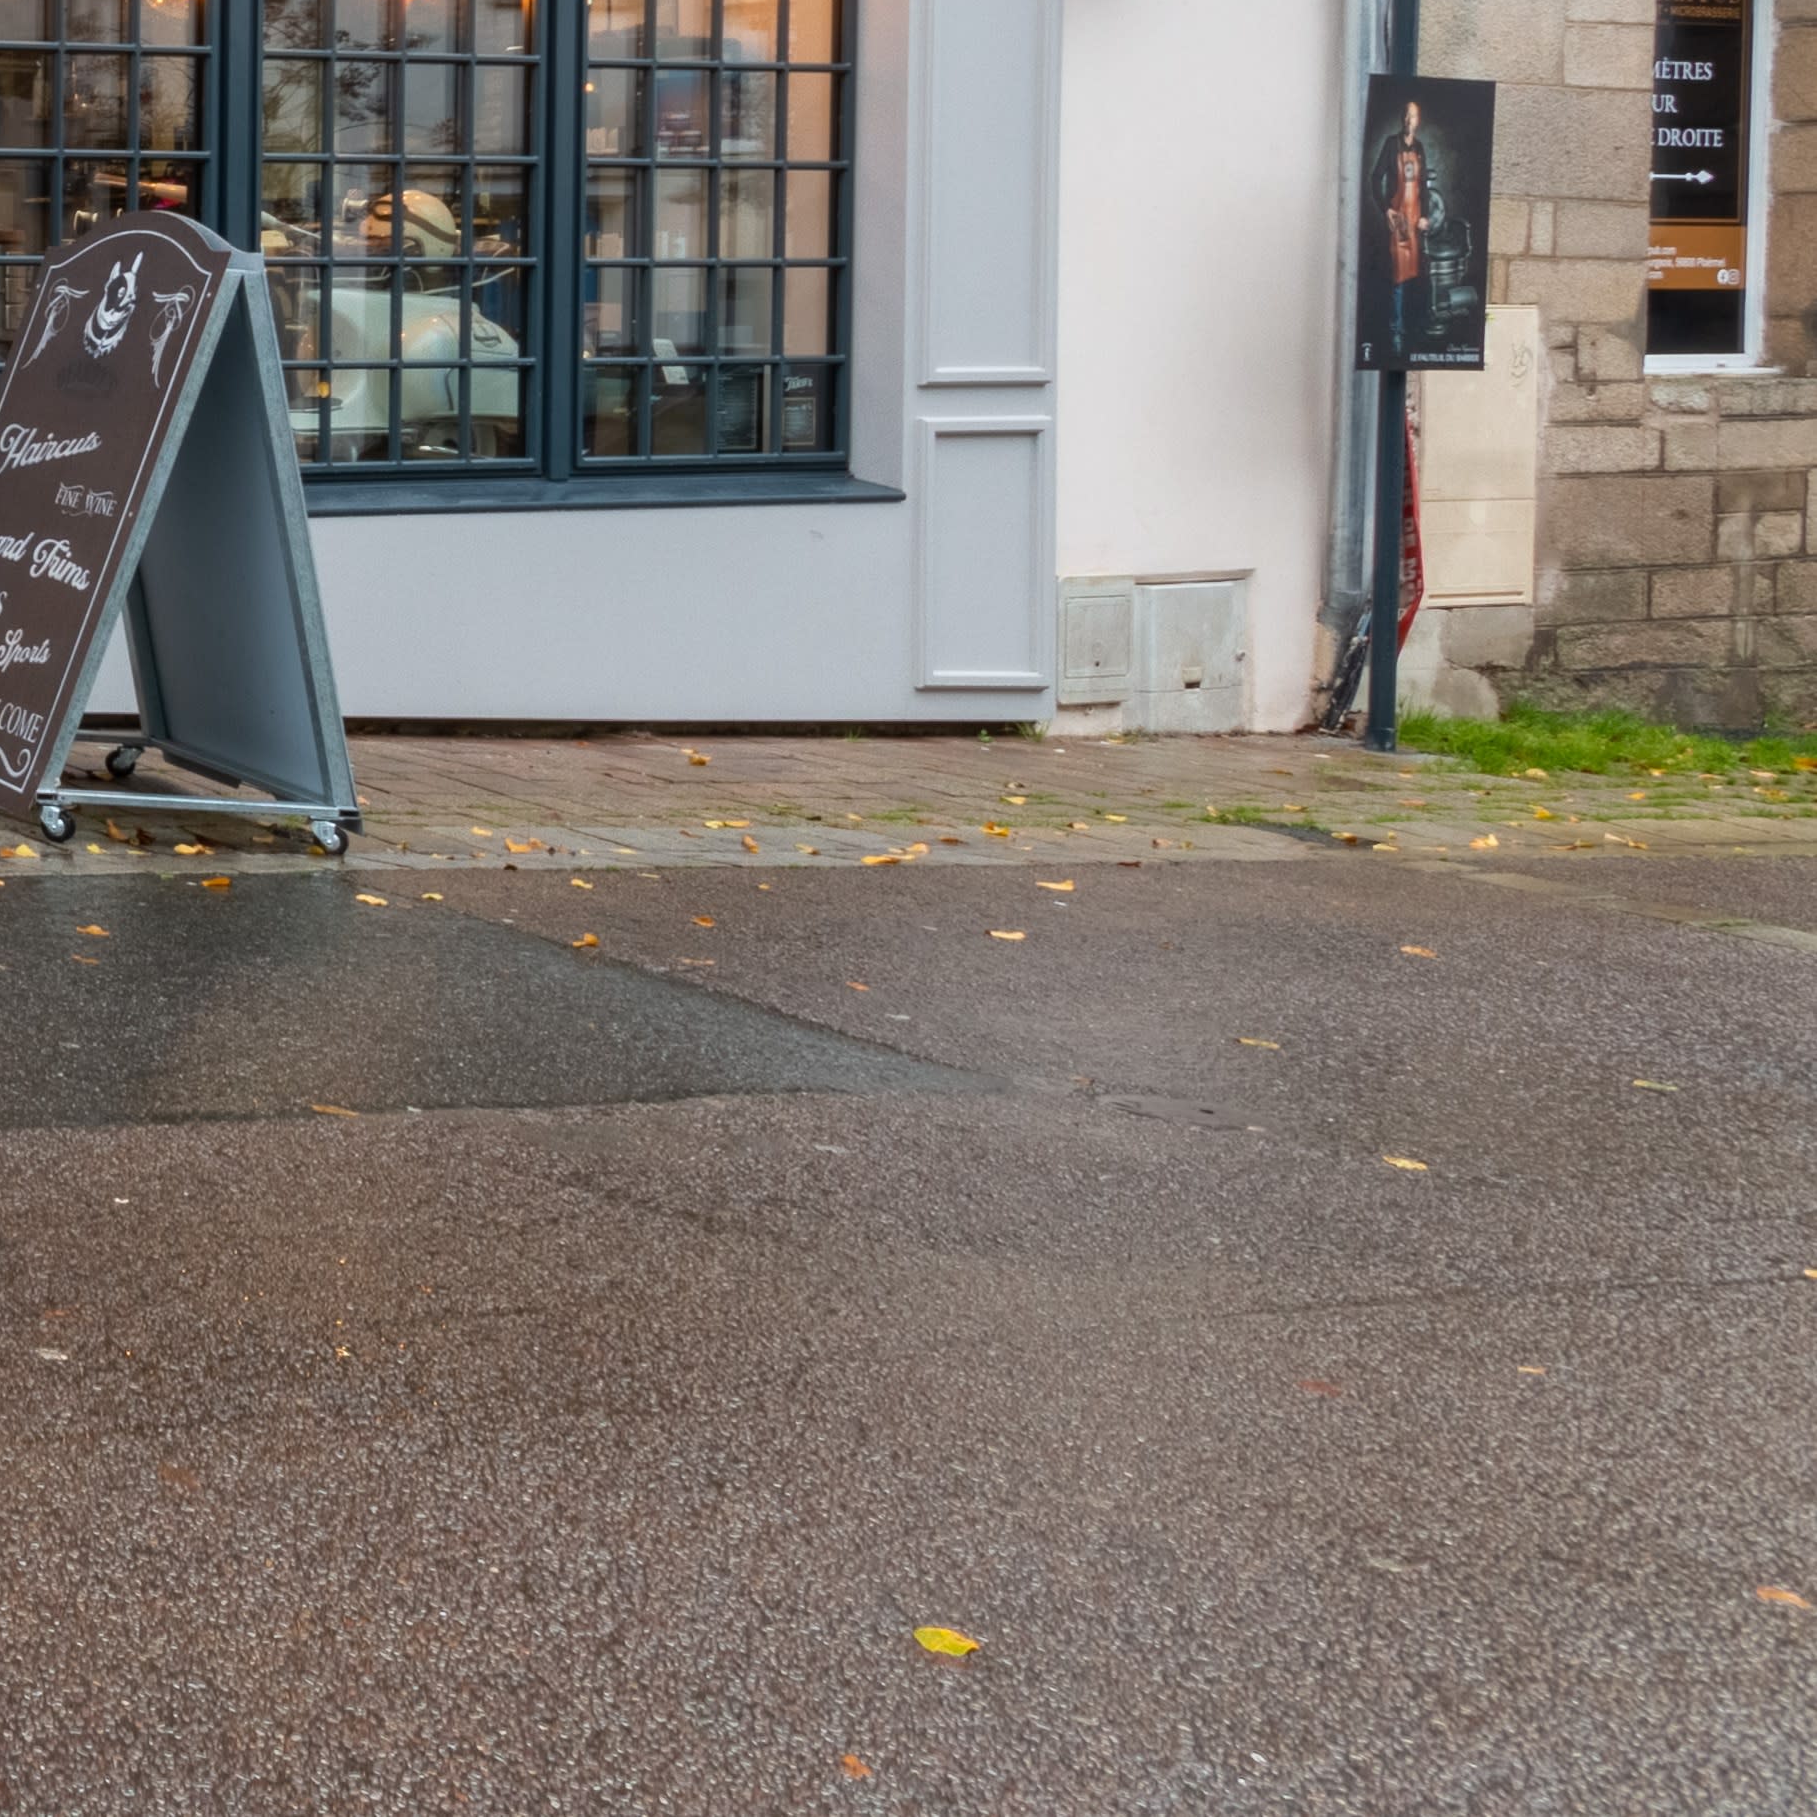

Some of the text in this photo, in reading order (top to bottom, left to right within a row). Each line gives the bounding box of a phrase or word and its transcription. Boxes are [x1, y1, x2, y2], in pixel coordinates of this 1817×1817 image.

[1657, 127, 1724, 147] DROITE
[54, 483, 118, 518] FINE WINE
[30, 538, 91, 592] Trims
